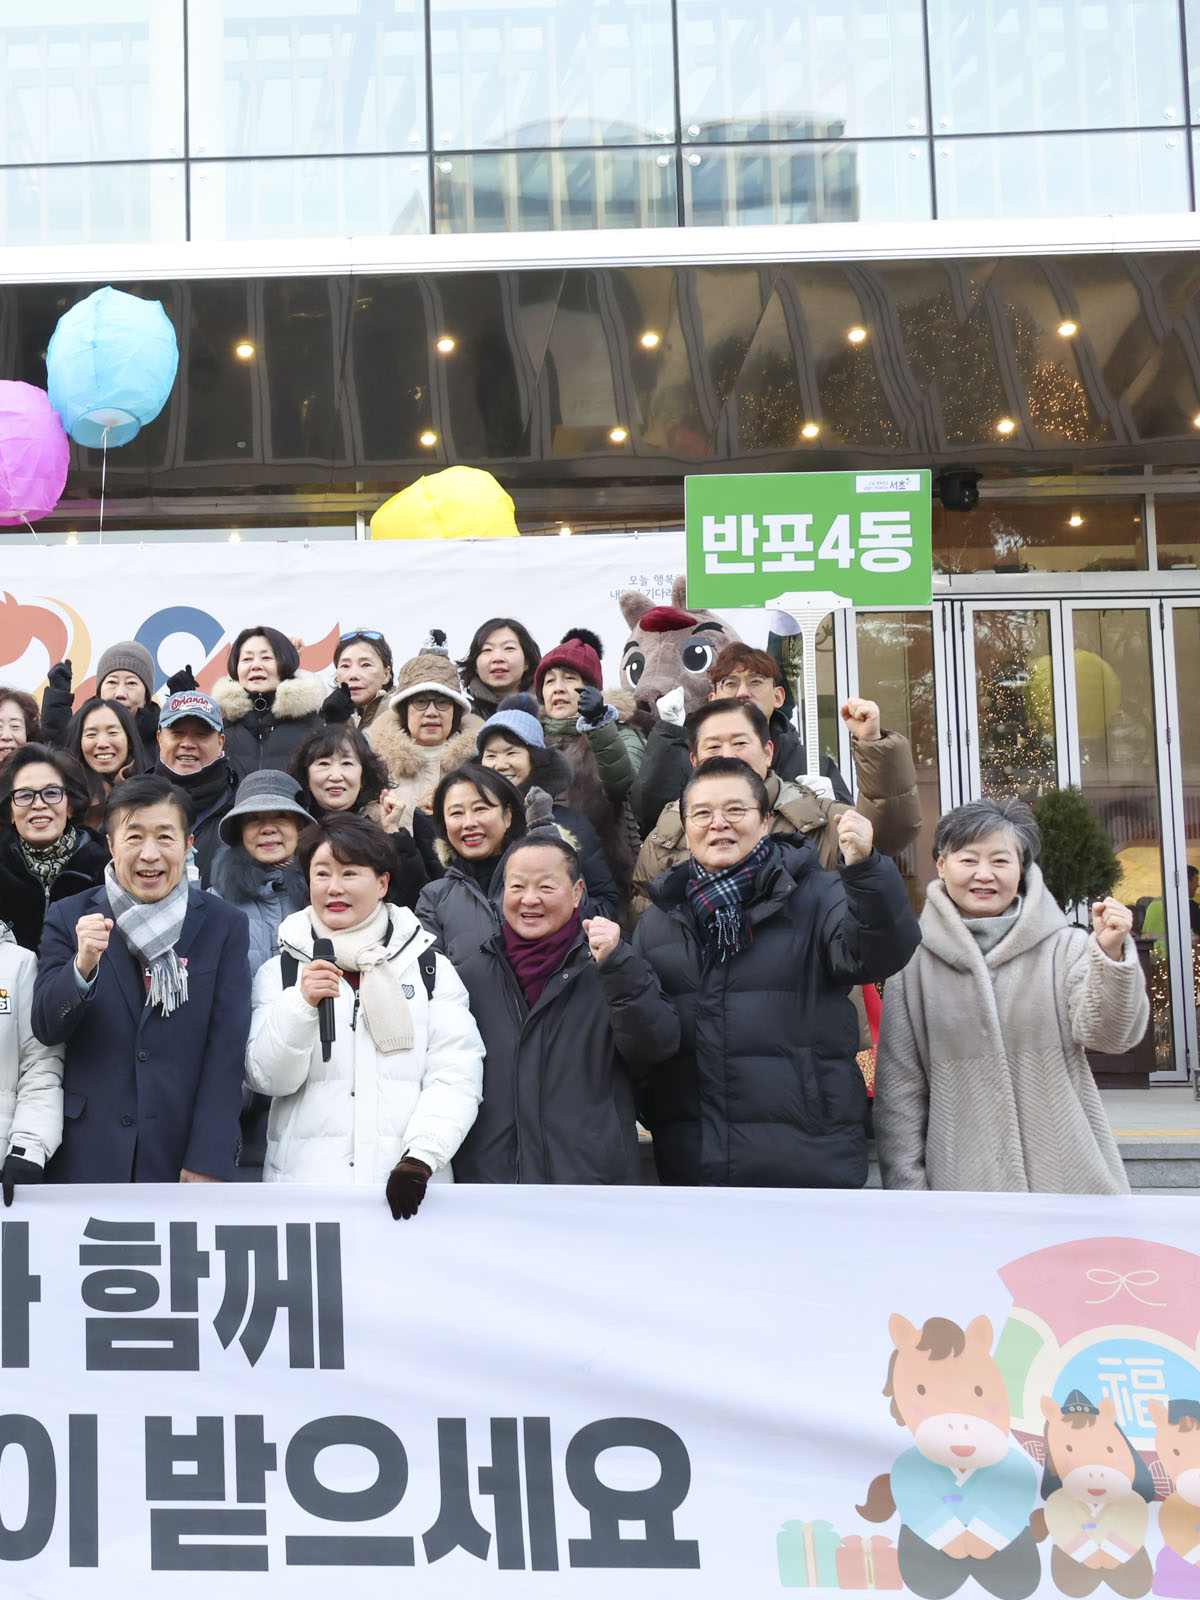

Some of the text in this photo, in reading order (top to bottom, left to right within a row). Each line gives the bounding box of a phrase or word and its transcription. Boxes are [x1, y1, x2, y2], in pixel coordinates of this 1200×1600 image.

[629, 574, 650, 587] 오늘
[702, 510, 913, 575] 반포4동
[79, 1217, 345, 1372] 함께
[144, 1414, 701, 1572] 받으세요
